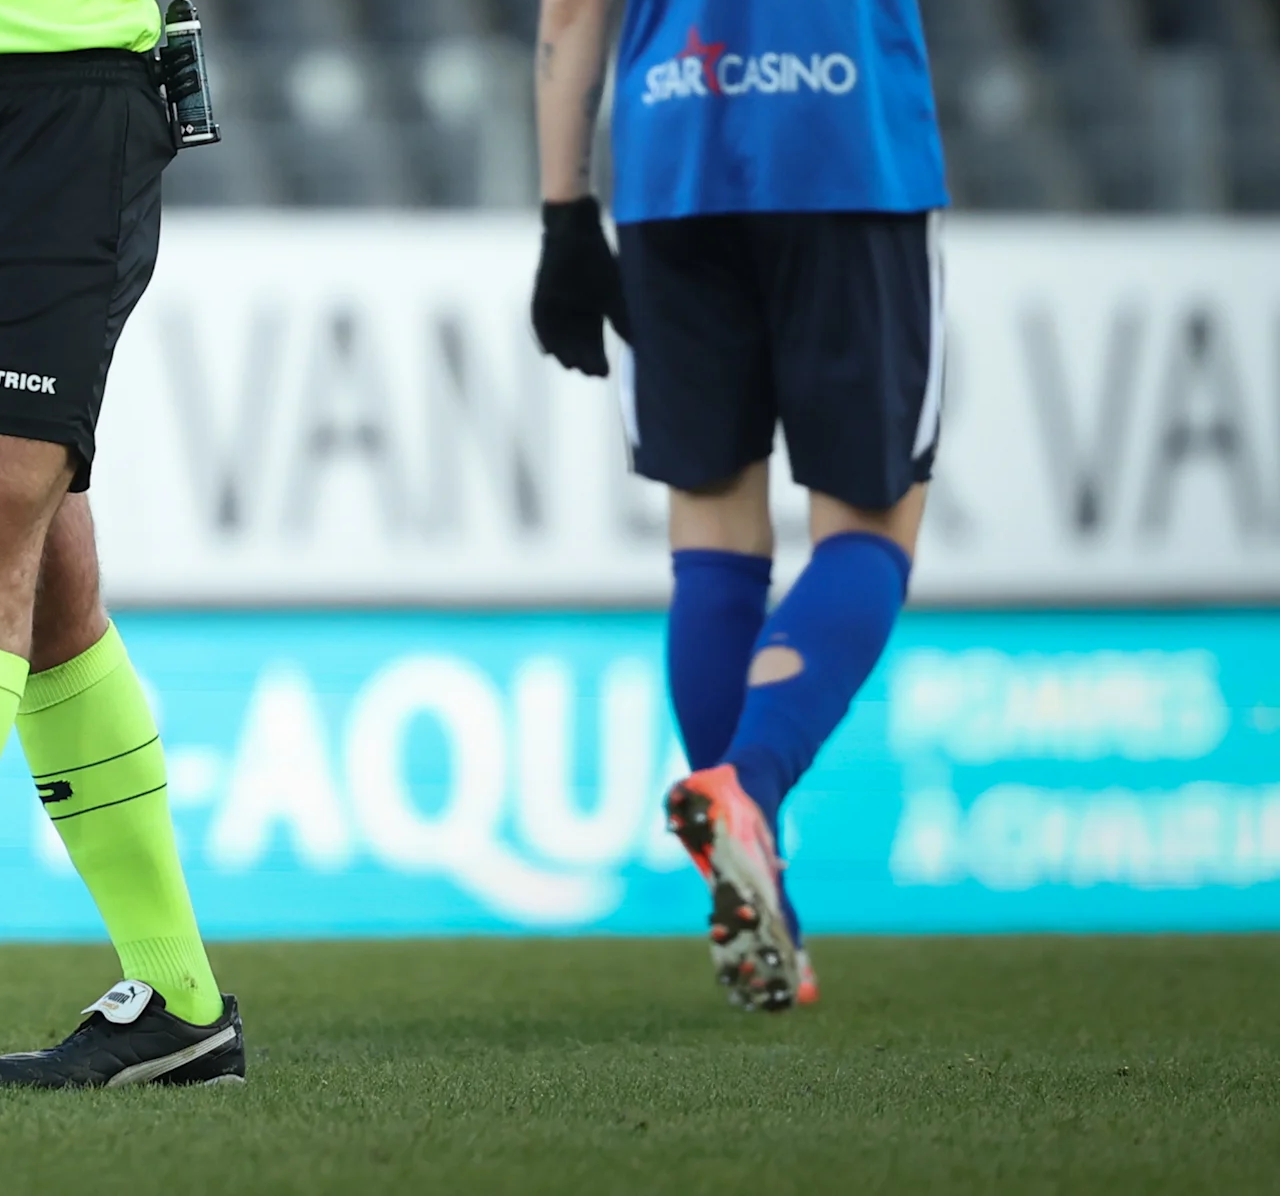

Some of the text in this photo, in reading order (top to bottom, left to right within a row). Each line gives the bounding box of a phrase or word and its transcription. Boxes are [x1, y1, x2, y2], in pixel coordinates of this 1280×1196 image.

[717, 52, 857, 95] CASINO
[156, 294, 557, 544] VAN
[1014, 292, 1280, 550] VA
